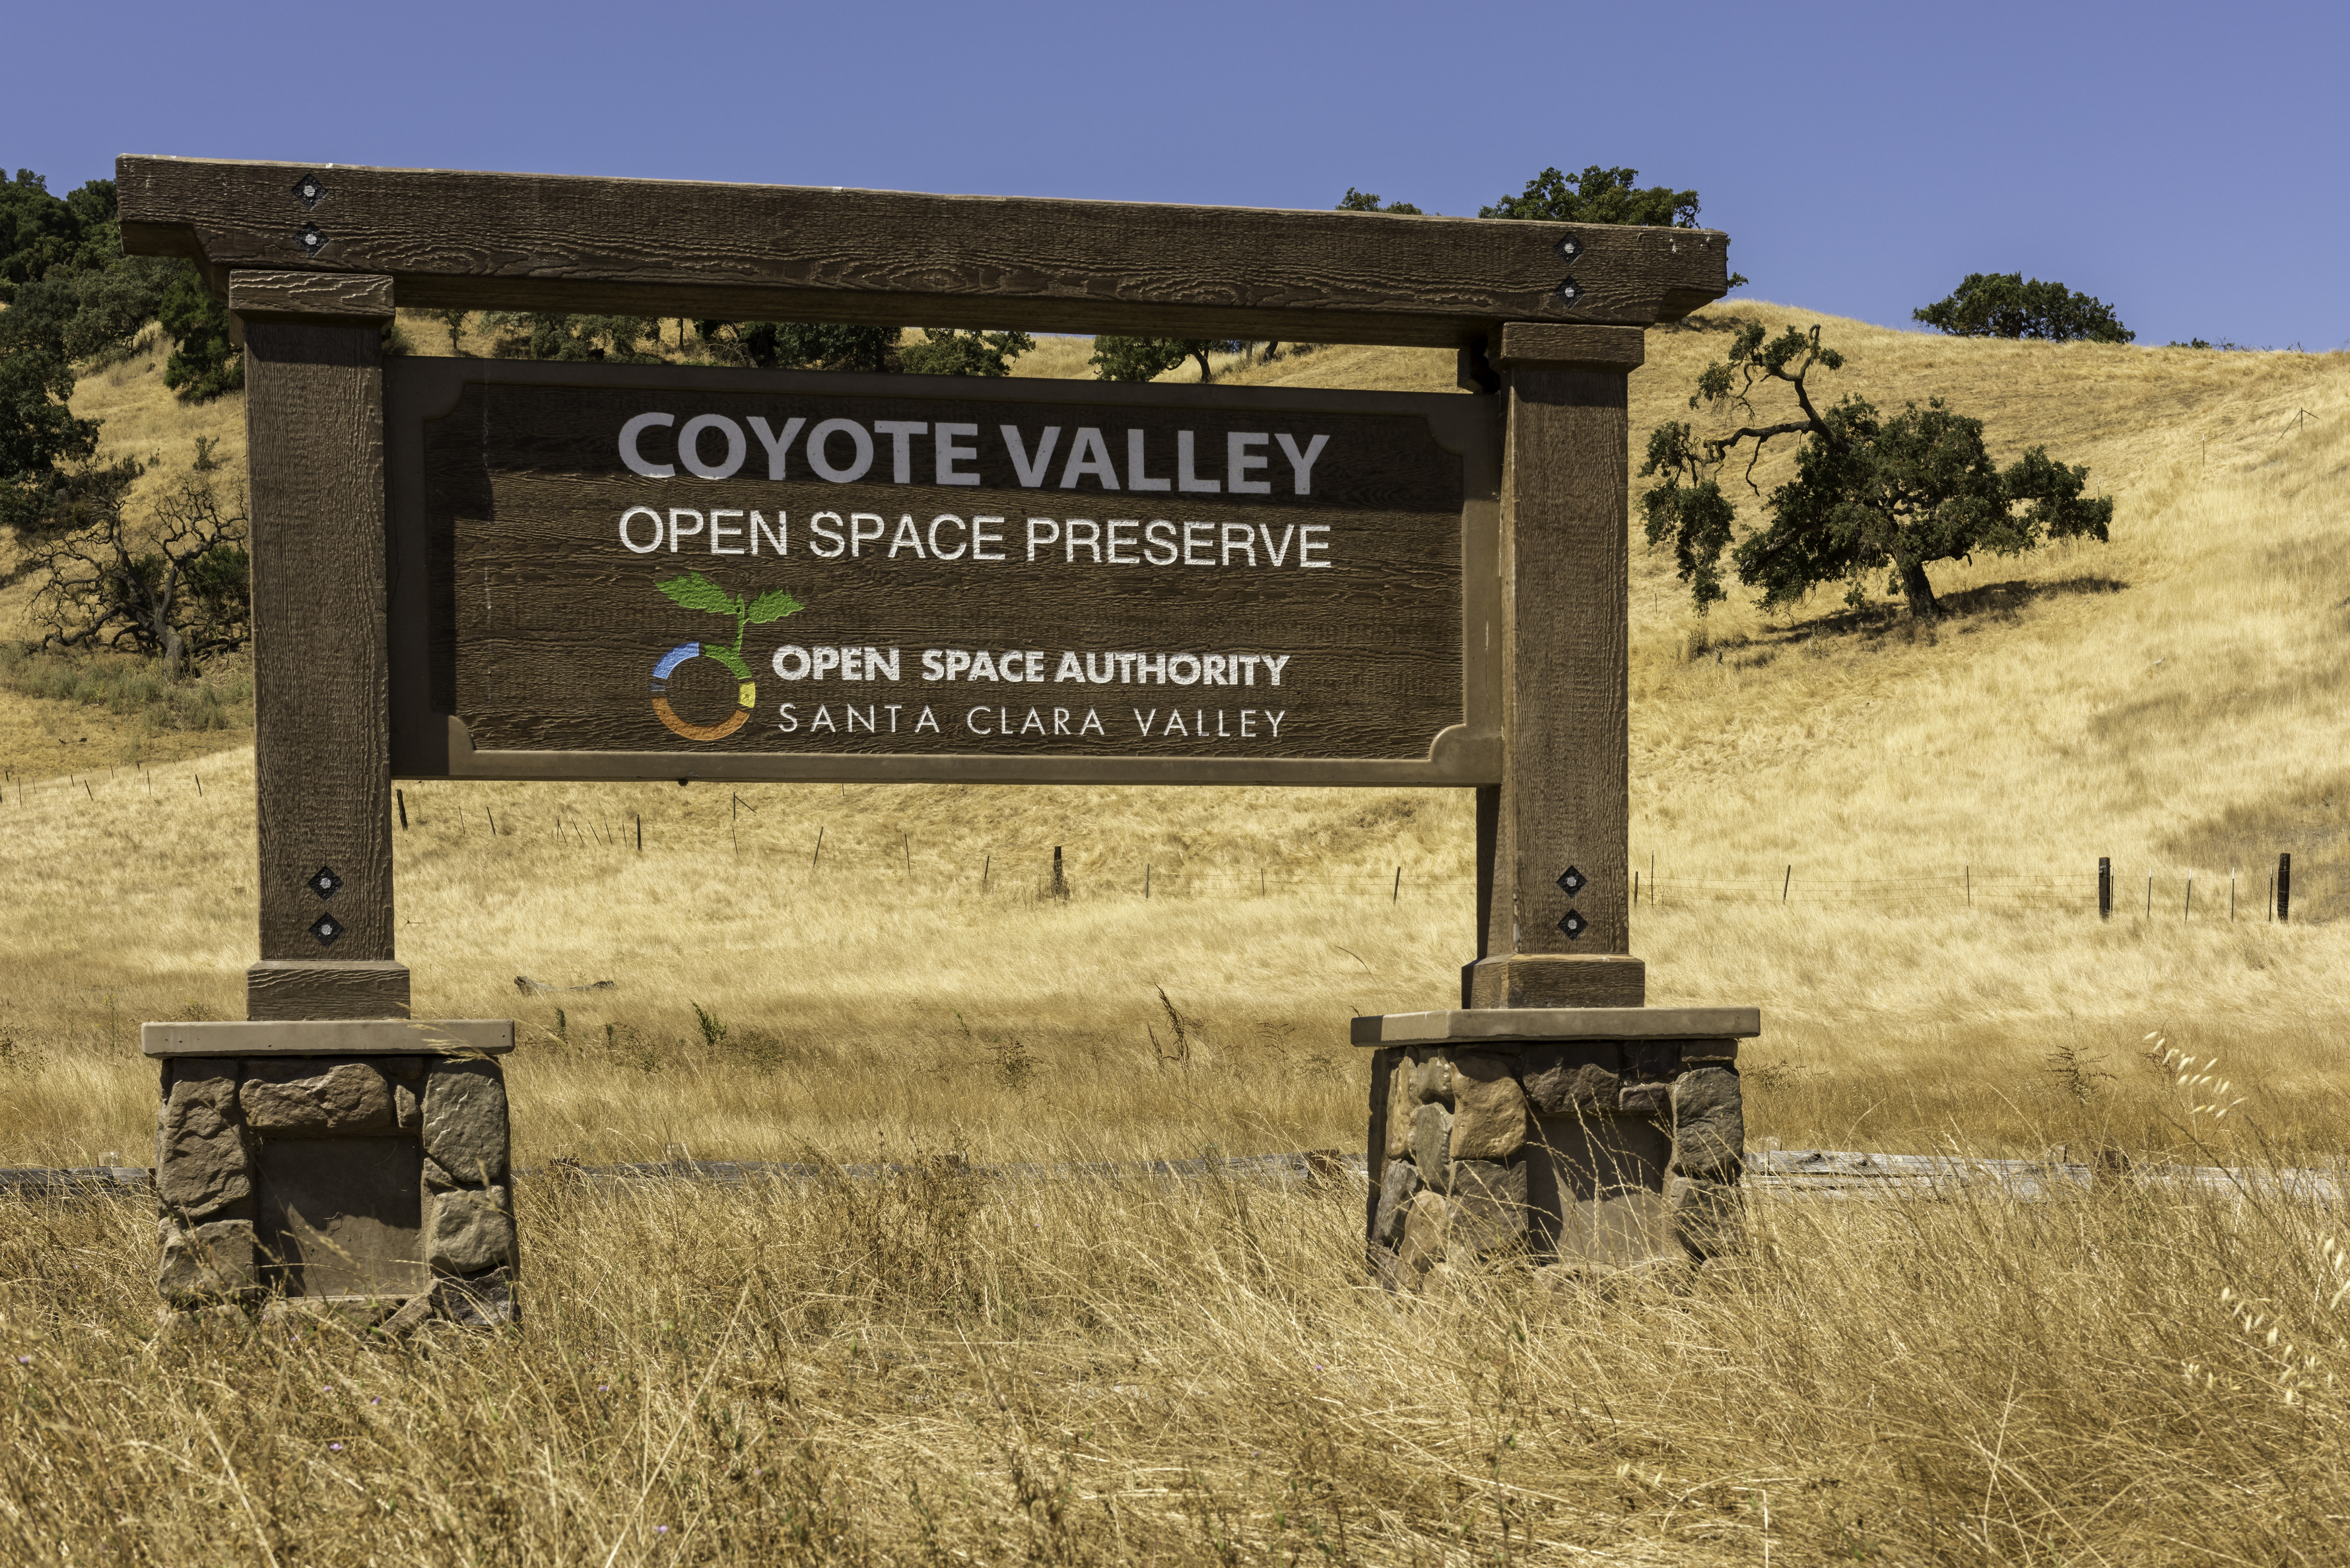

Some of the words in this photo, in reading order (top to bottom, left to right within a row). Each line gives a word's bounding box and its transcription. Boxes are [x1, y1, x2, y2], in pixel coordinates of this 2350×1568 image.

[619, 412, 981, 486] COYOTE
[1000, 425, 1331, 496] VALLEY
[619, 506, 788, 556] OPEN
[809, 511, 1006, 560] SPACE
[1026, 517, 1332, 568] PRESERVE
[772, 644, 900, 681] OPEN
[922, 649, 1044, 683] SPACE
[1054, 651, 1291, 686] AUTHORITY
[778, 702, 941, 733] SANTA
[966, 705, 1106, 736] CLARA
[1133, 708, 1287, 738] VALLEY
